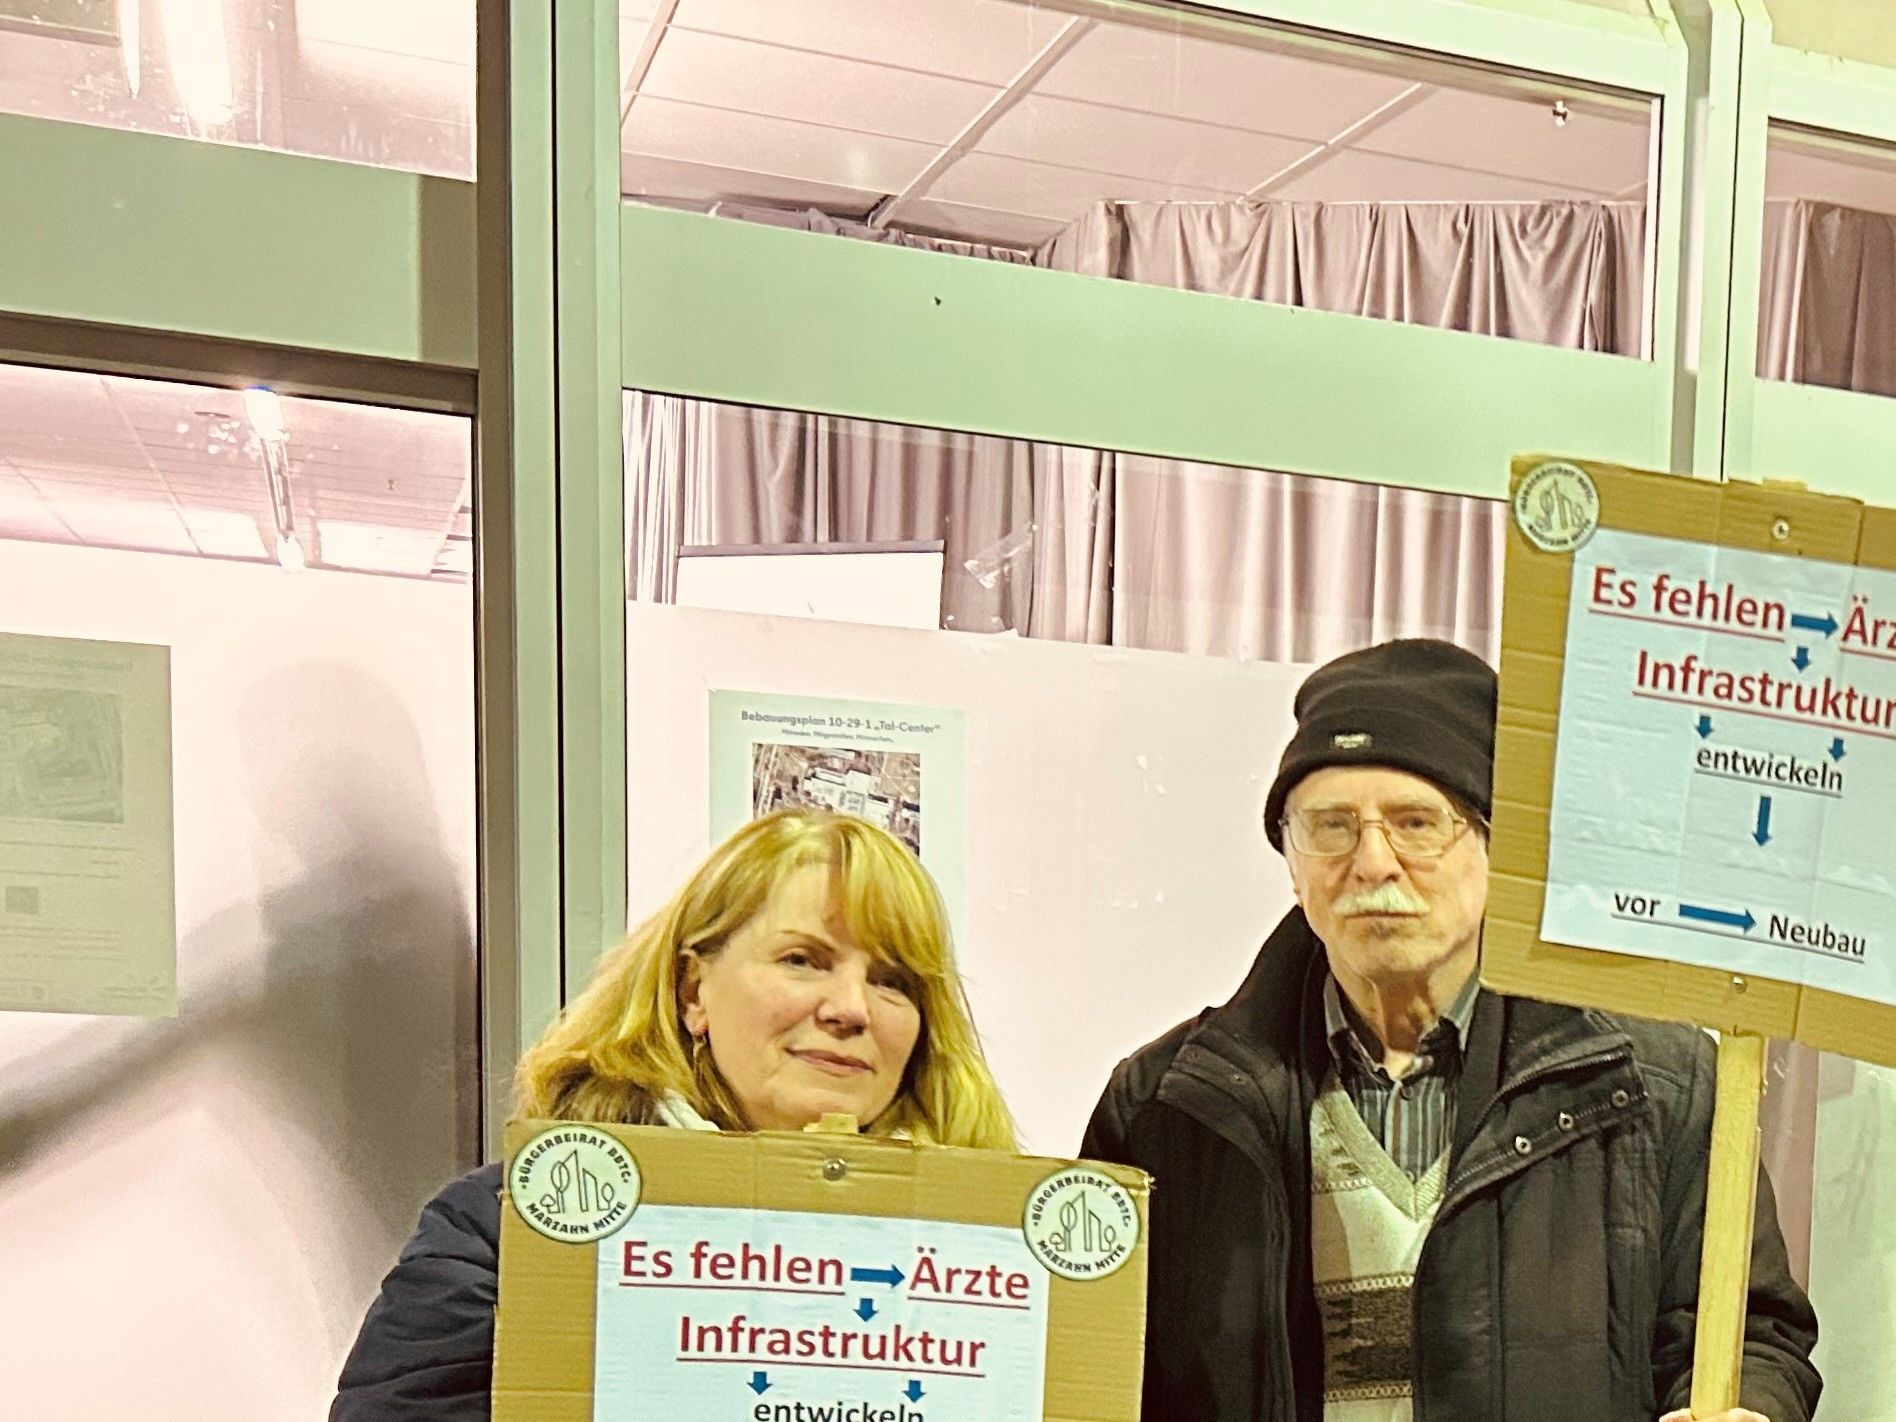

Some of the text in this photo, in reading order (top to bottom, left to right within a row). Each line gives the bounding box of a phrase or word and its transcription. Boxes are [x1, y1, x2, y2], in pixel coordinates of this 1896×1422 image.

[1592, 567, 1637, 609] Es
[1652, 574, 1786, 632] fehlen
[1696, 744, 1844, 792] entwickeln
[1614, 894, 1866, 957] vor Neubau
[519, 1132, 608, 1184] BÜRGERBEIRAT
[526, 1201, 627, 1234] MARZAHN MITTE
[621, 1241, 1030, 1300] Es fehlen Ärzte
[1095, 1243, 1127, 1271] MITTE
[679, 1315, 986, 1368] Infrastruktur
